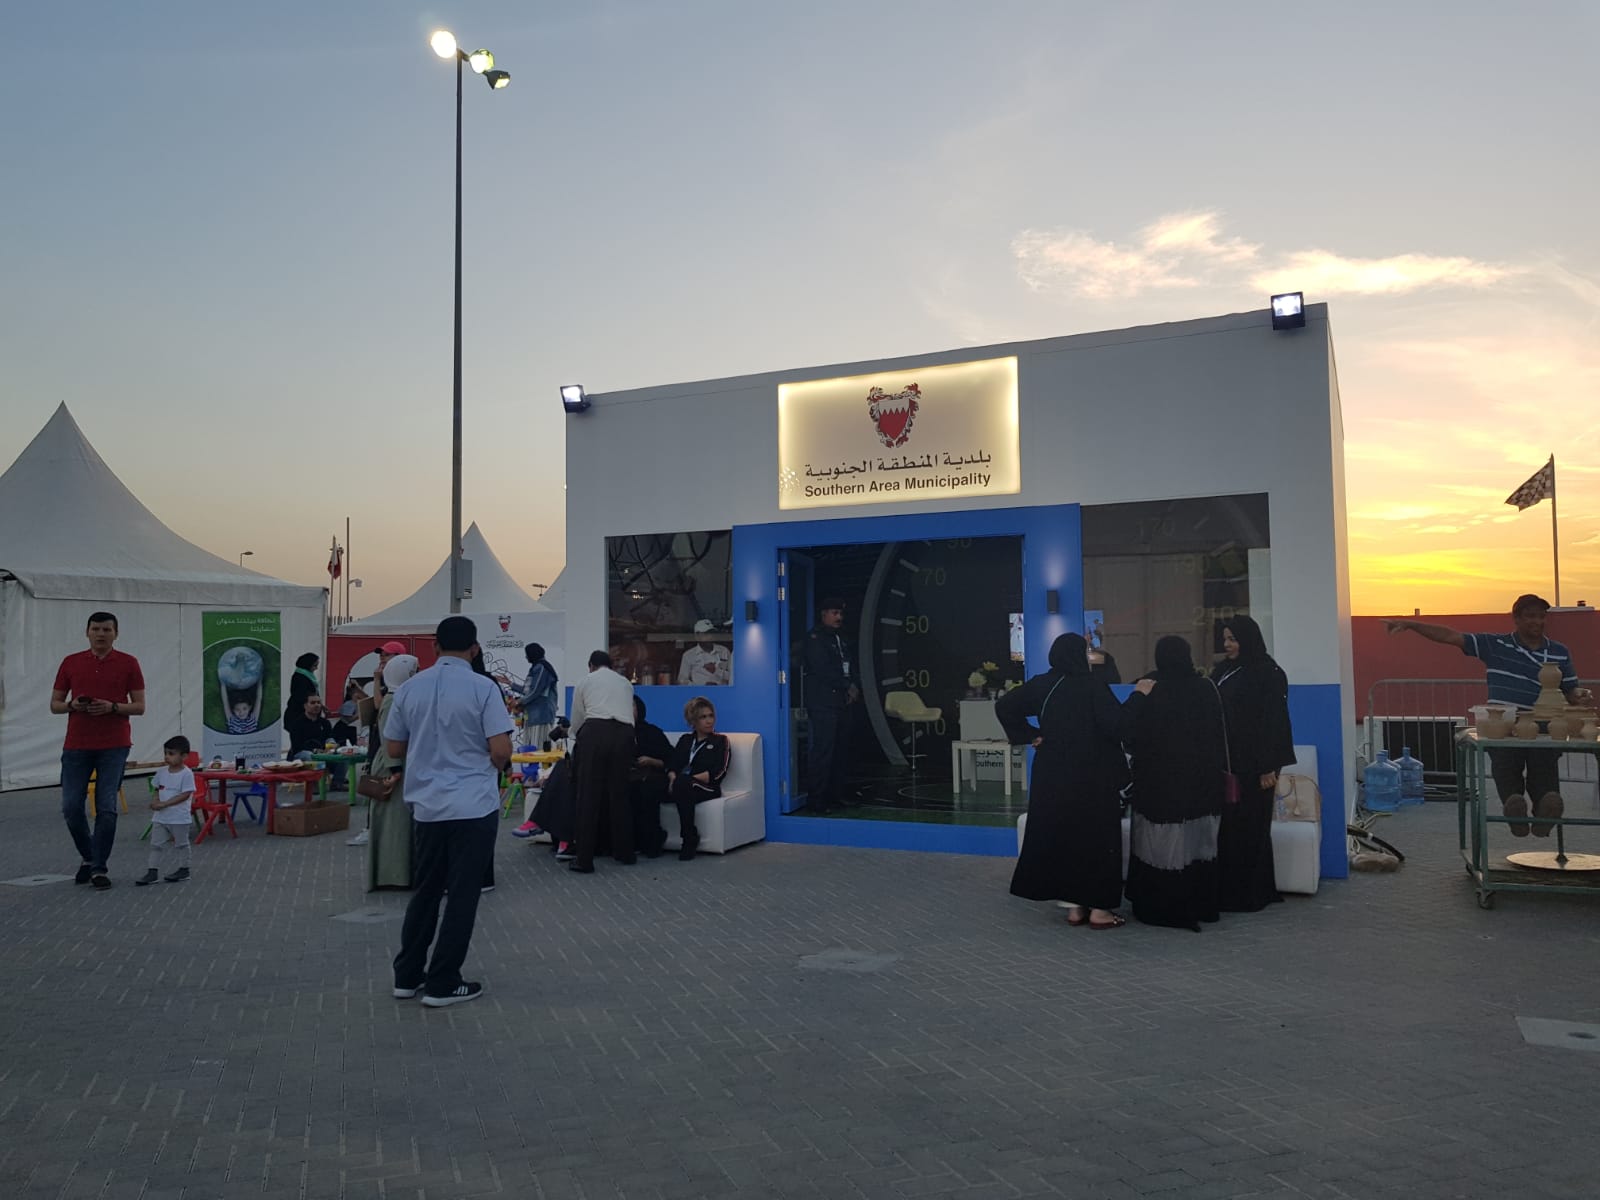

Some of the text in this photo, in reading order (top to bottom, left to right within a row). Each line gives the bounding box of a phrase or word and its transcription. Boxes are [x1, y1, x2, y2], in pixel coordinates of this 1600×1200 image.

[805, 449, 992, 481] بلدية المنطقة الجنوبية
[805, 472, 992, 498] Southern Area Municipality
[922, 567, 946, 587] 70
[905, 615, 930, 634] 50
[905, 669, 930, 689] 30
[975, 760, 1004, 769] outhern
